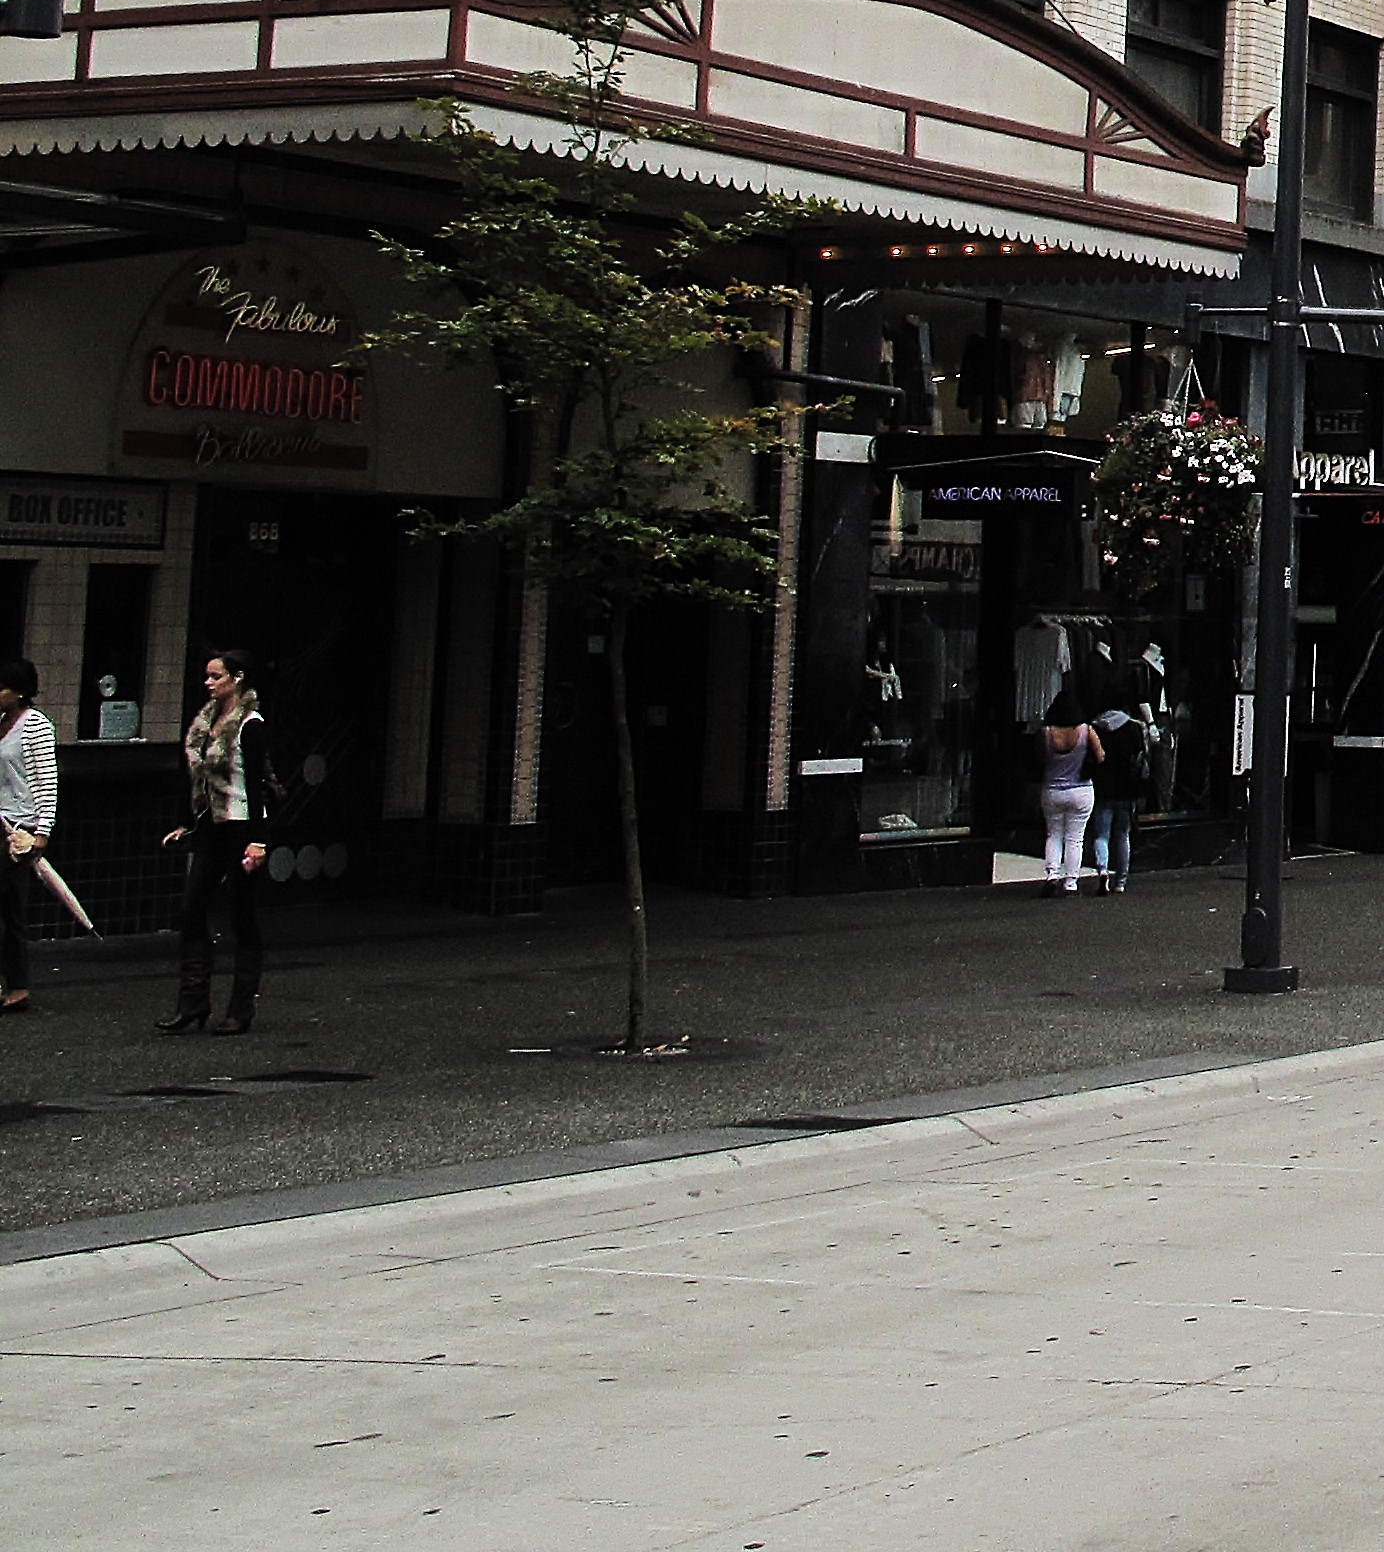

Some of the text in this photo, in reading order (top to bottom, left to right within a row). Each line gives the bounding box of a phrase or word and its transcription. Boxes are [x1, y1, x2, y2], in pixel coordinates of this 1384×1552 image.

[196, 265, 231, 295] The
[220, 291, 340, 344] Fabulous
[150, 350, 364, 425] COMMODORE
[8, 494, 127, 528] BOX OFFICE
[928, 486, 1063, 503] AMERICAN APPAREL
